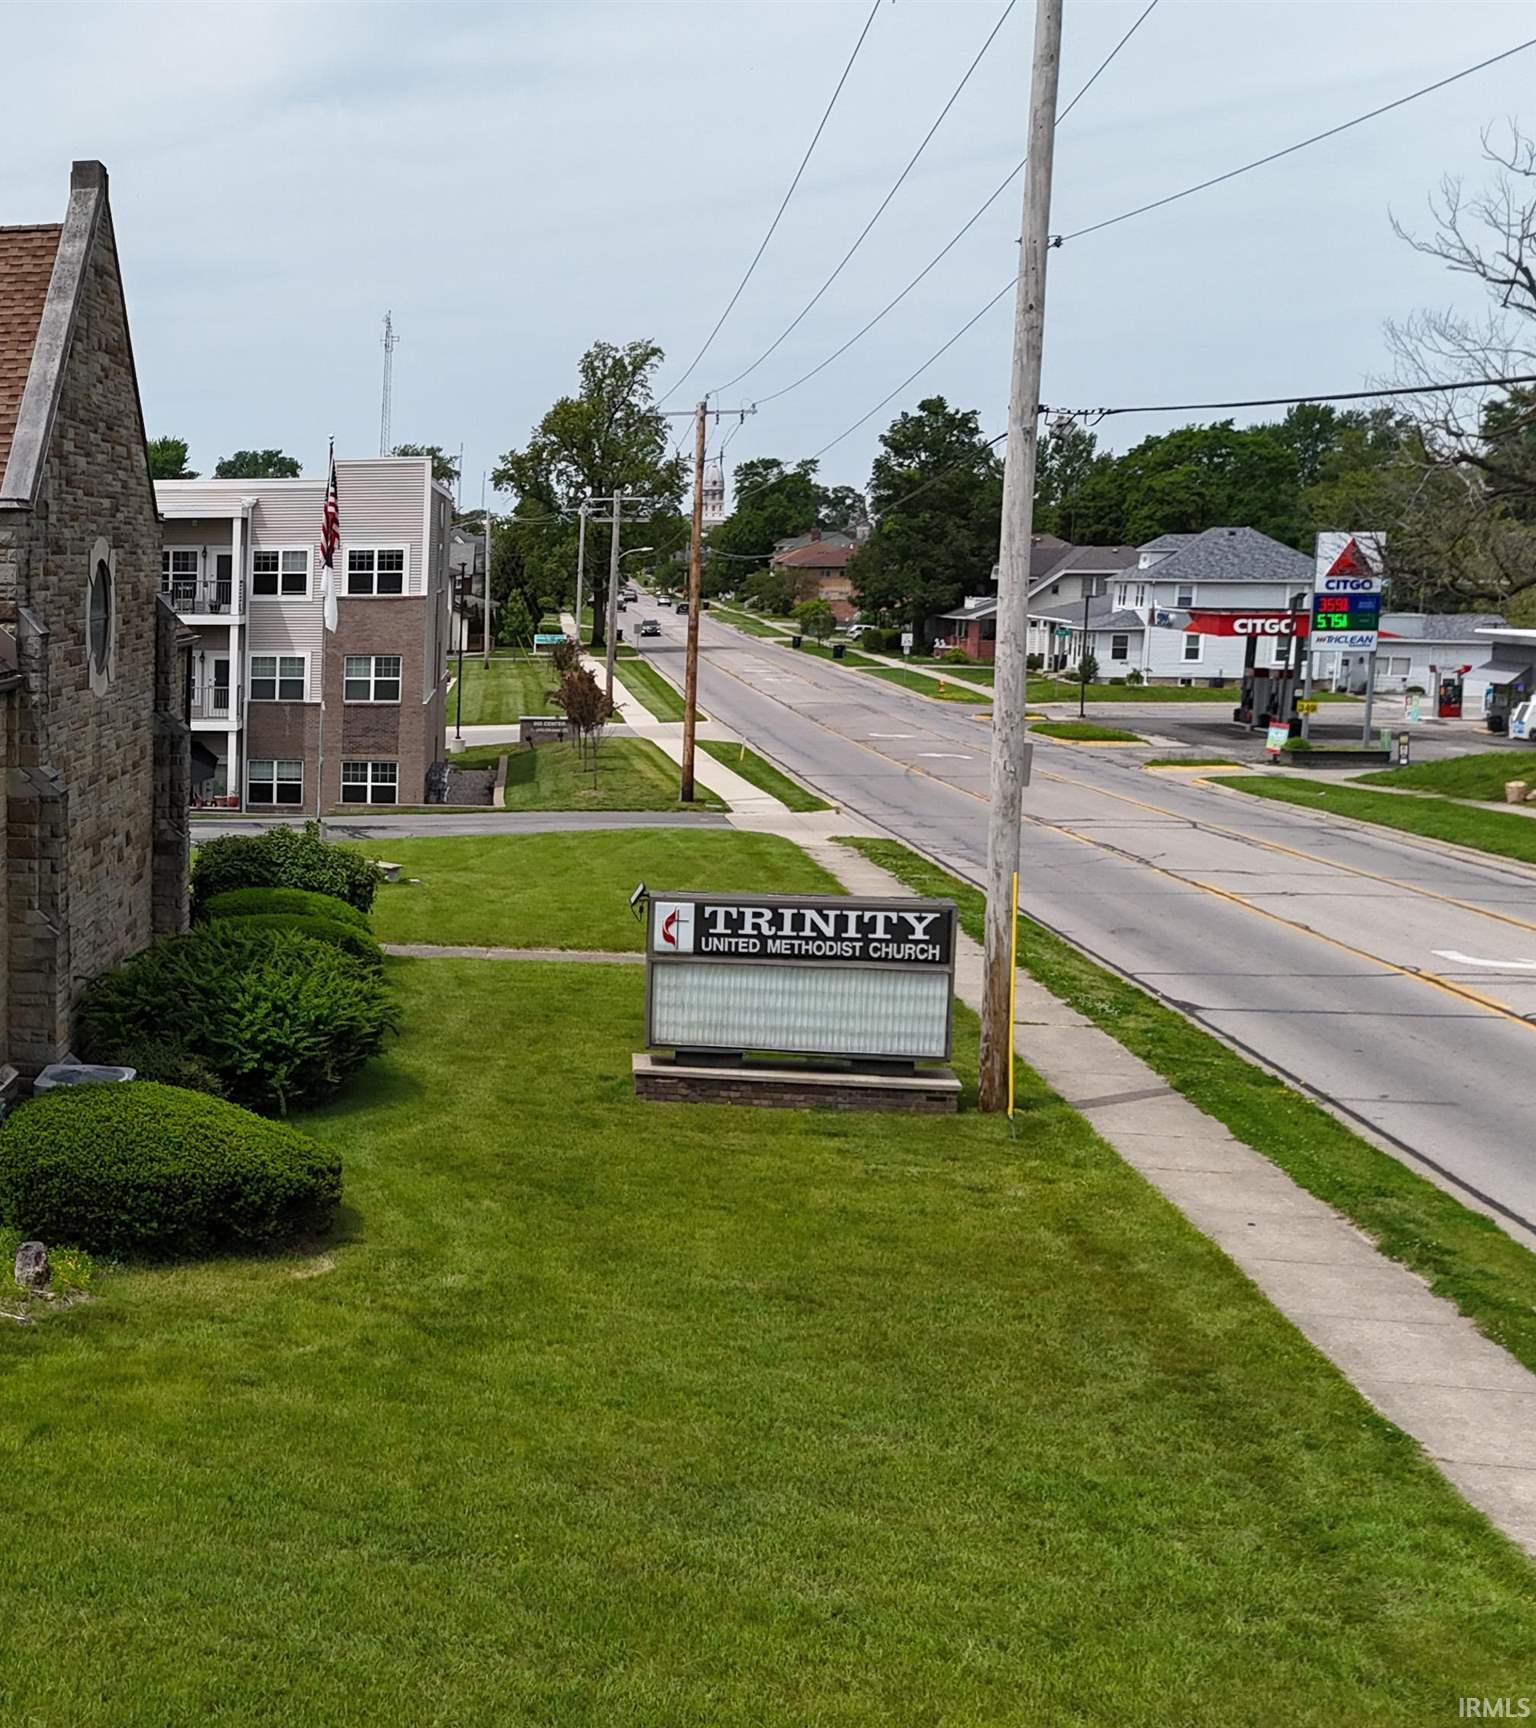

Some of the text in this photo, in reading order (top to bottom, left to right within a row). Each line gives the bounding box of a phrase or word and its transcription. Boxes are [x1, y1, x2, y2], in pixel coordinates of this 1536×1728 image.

[1325, 579, 1373, 591] CITGO
[1232, 618, 1297, 634] CITGO
[704, 906, 940, 940] TRINITY
[701, 936, 941, 961] UNITED METHODIST CHURCH
